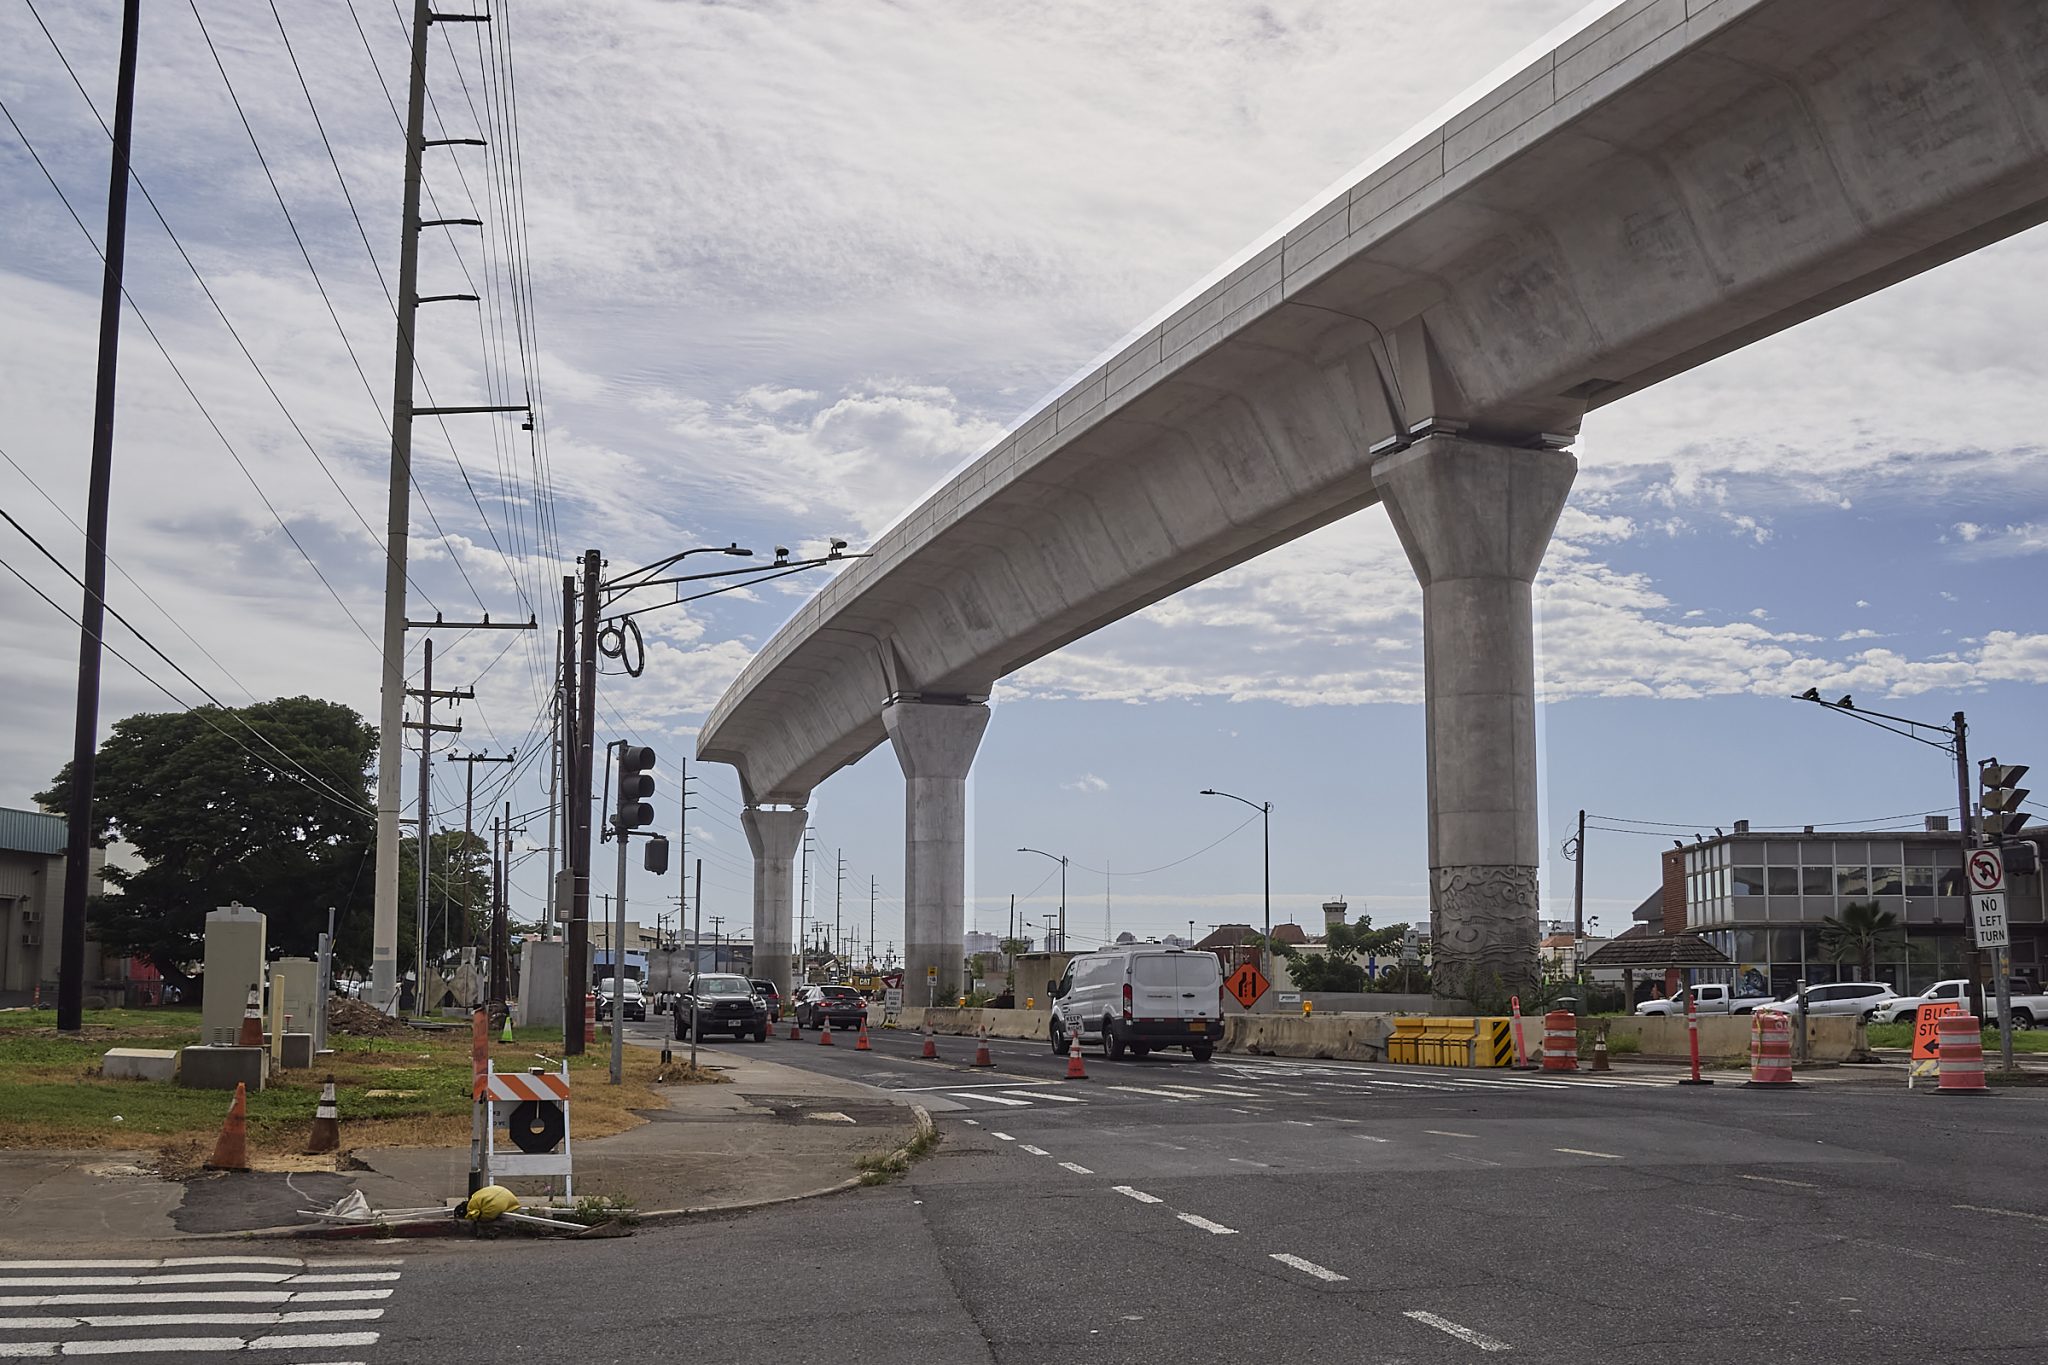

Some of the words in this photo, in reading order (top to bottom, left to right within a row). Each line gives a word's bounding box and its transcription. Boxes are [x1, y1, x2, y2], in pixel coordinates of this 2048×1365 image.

[1981, 899, 1997, 911] NO
[1979, 915, 2002, 927] LEFT
[1980, 930, 2005, 941] TURN
